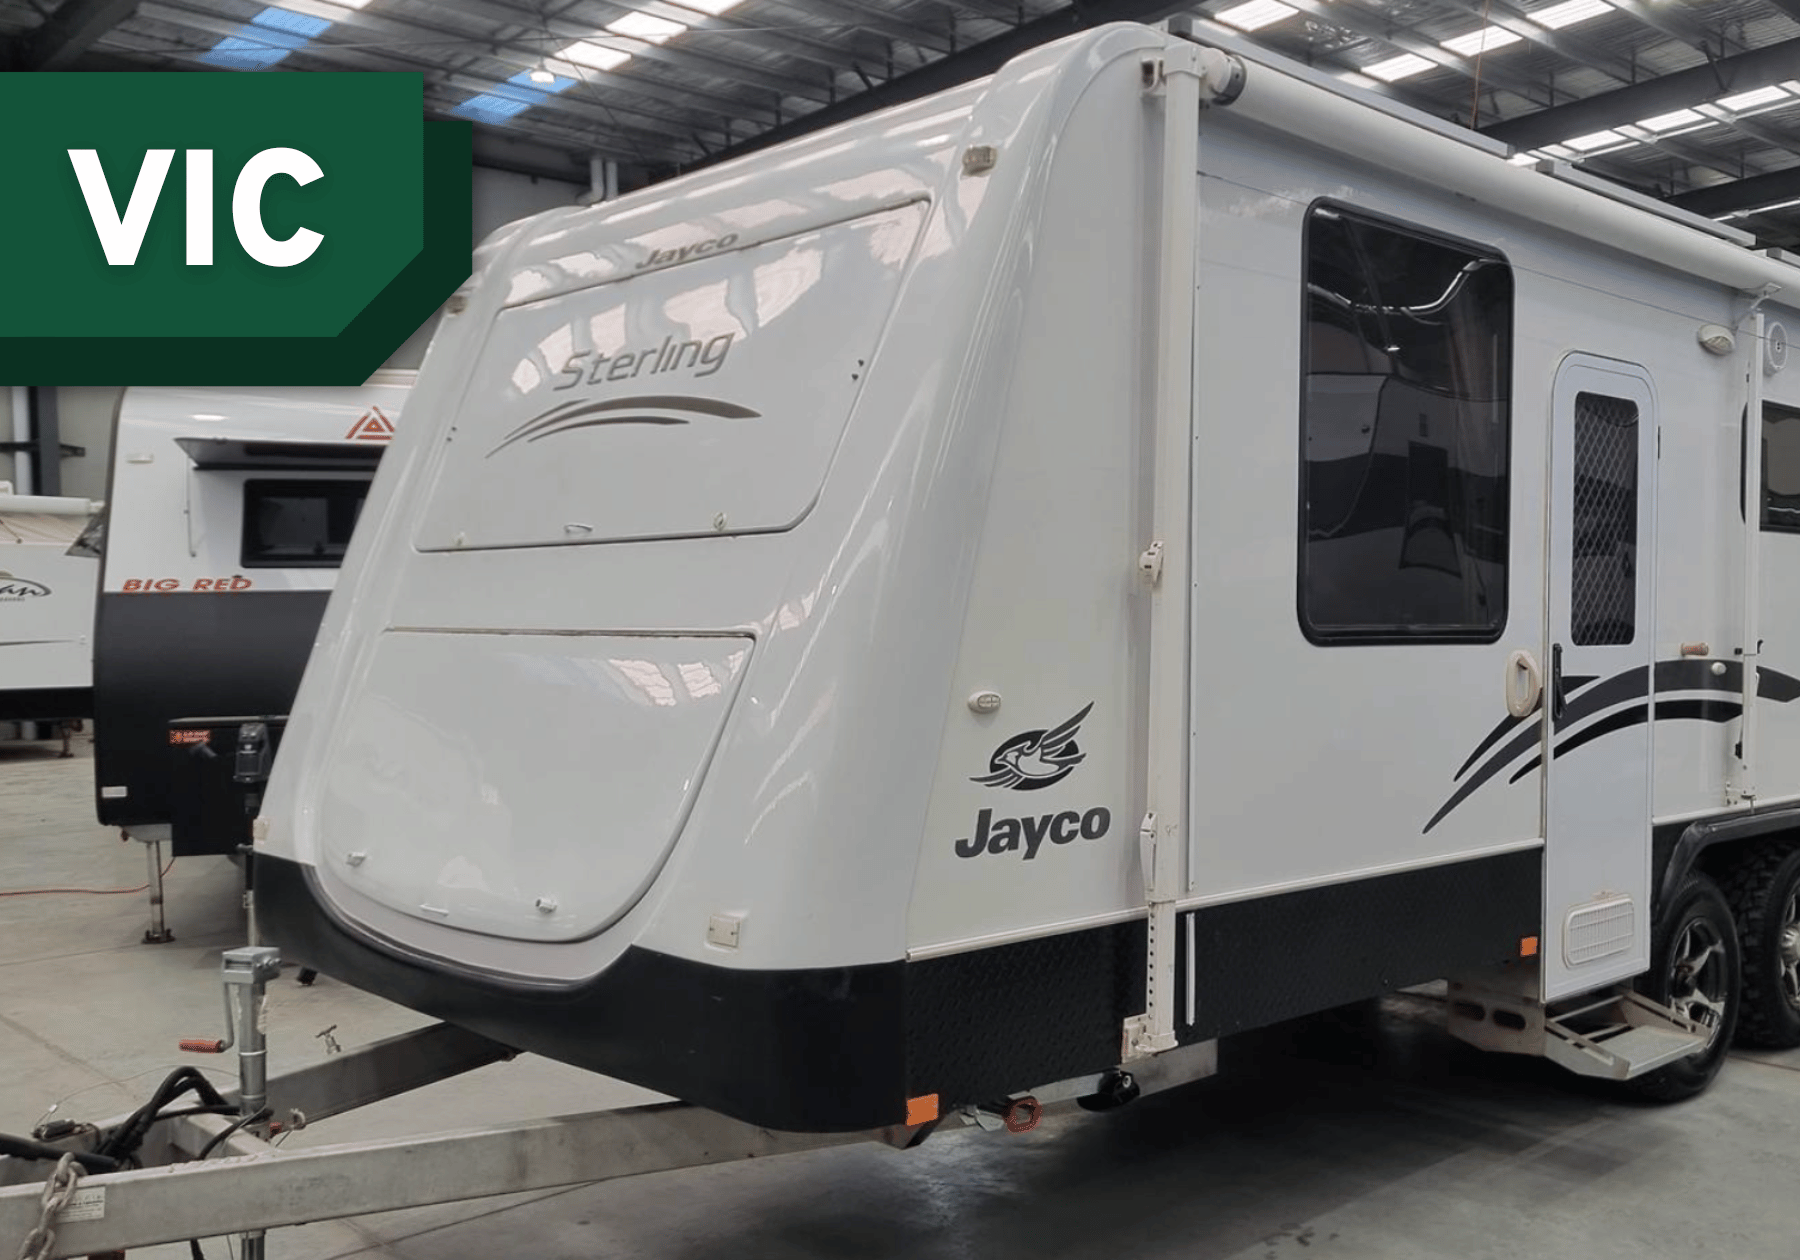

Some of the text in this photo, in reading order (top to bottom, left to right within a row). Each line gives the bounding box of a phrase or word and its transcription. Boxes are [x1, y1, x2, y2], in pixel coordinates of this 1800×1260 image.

[634, 233, 739, 270] Jayco
[552, 332, 735, 391] Sterling
[123, 578, 252, 592] BIG RED
[955, 806, 1111, 861] Jayco
